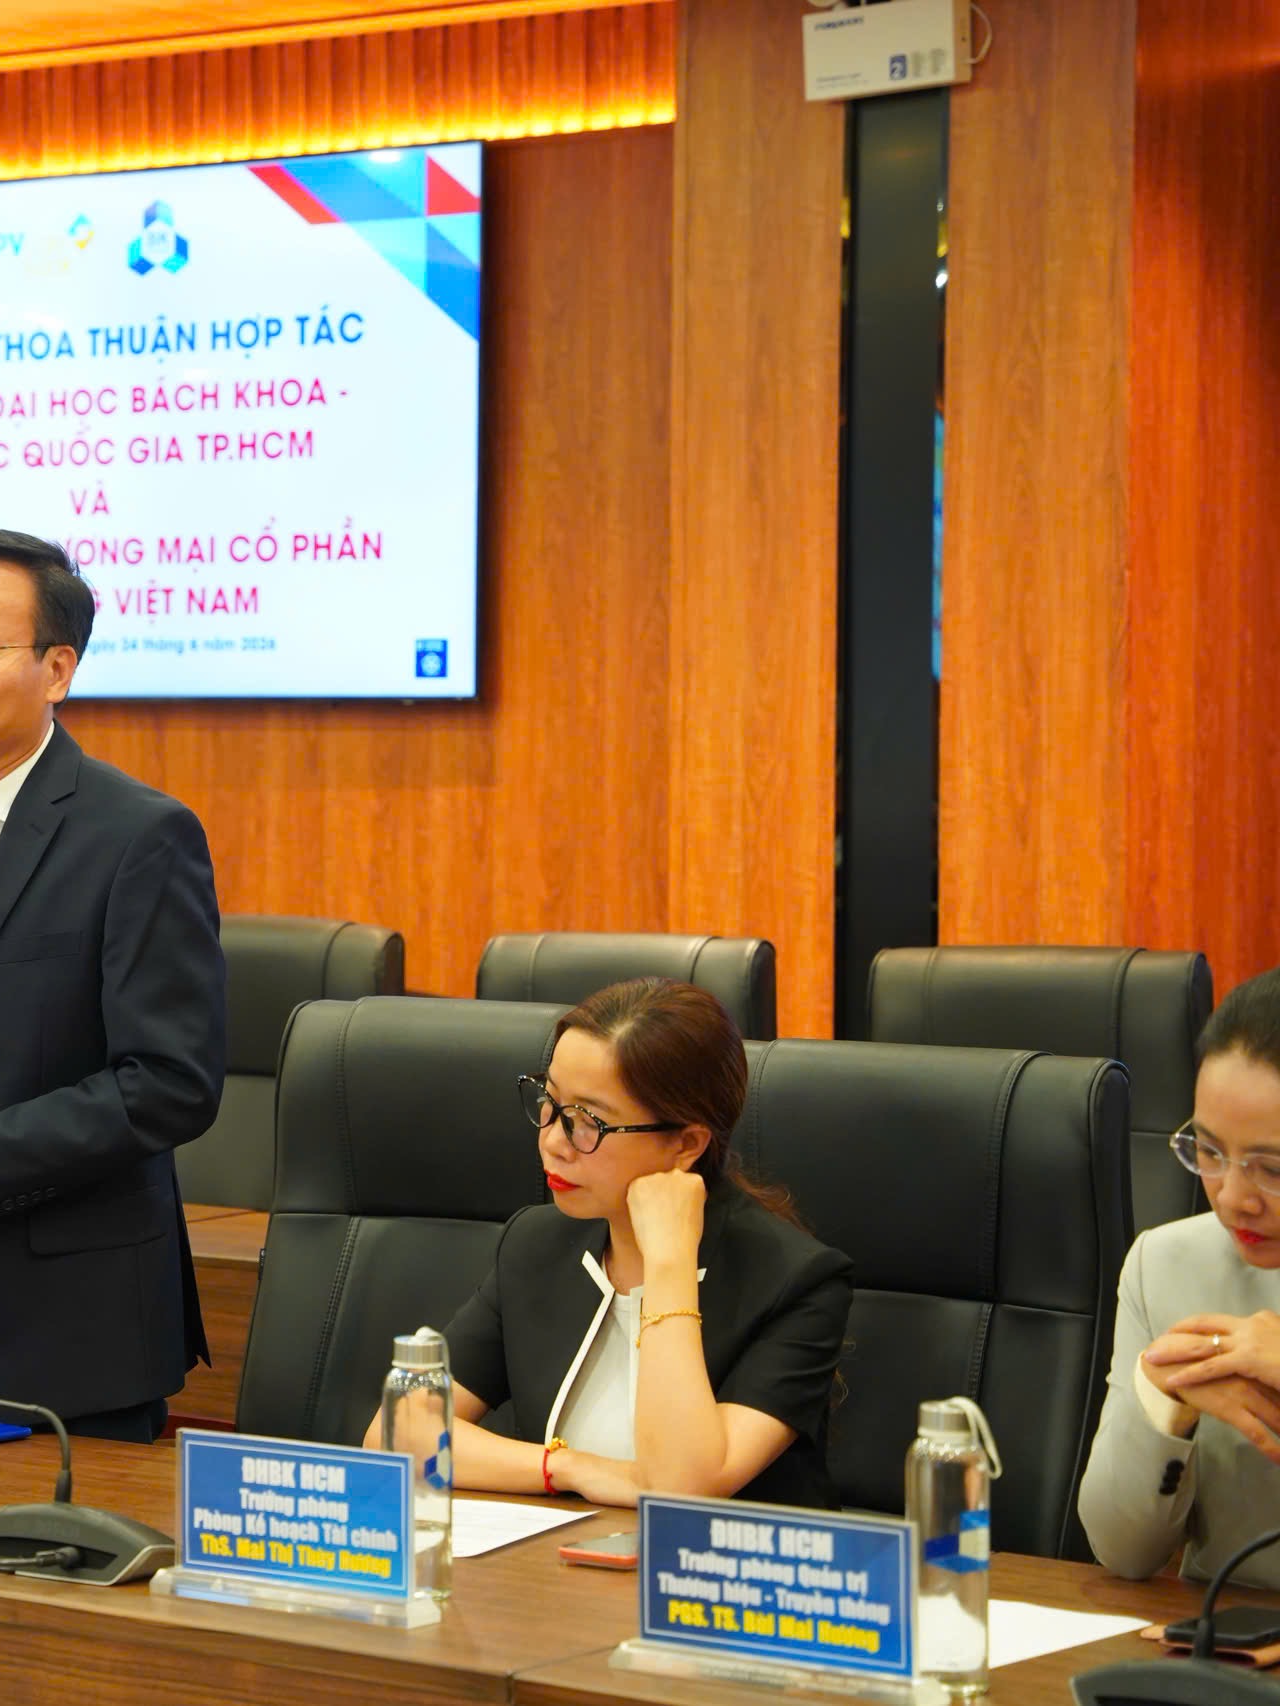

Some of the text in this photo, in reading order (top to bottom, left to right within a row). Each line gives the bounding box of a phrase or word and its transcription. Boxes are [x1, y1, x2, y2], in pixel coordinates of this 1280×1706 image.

[87, 314, 196, 363] THUẬN
[211, 313, 282, 360] HỢP
[295, 304, 364, 347] TÁC
[131, 376, 219, 414] BÁCH
[234, 376, 327, 409] KHOA
[23, 426, 115, 468] QUỐC
[128, 436, 184, 464] GIA
[196, 430, 313, 461] TP.HCM
[157, 536, 215, 574] MẠI
[229, 515, 278, 562] CỔ
[115, 578, 174, 625] VIỆT
[187, 586, 258, 616] NAM
[241, 1456, 346, 1494] ĐHBK HCM
[194, 1507, 242, 1535] Phòng
[245, 1513, 266, 1536] Kế
[270, 1516, 319, 1544] hoạch
[351, 1527, 398, 1552] chính
[298, 1496, 349, 1523] phòng
[200, 1533, 233, 1557] ThS.
[236, 1537, 265, 1561] Mai
[269, 1541, 293, 1567] Thị
[339, 1551, 391, 1579] Hương
[710, 1518, 834, 1562] ĐHBK HCM
[740, 1557, 794, 1587] phòng
[846, 1570, 868, 1596] trị
[668, 1600, 709, 1627] PGS.
[712, 1605, 740, 1632] TS.
[779, 1614, 814, 1641] Mai
[839, 1596, 890, 1626] thông
